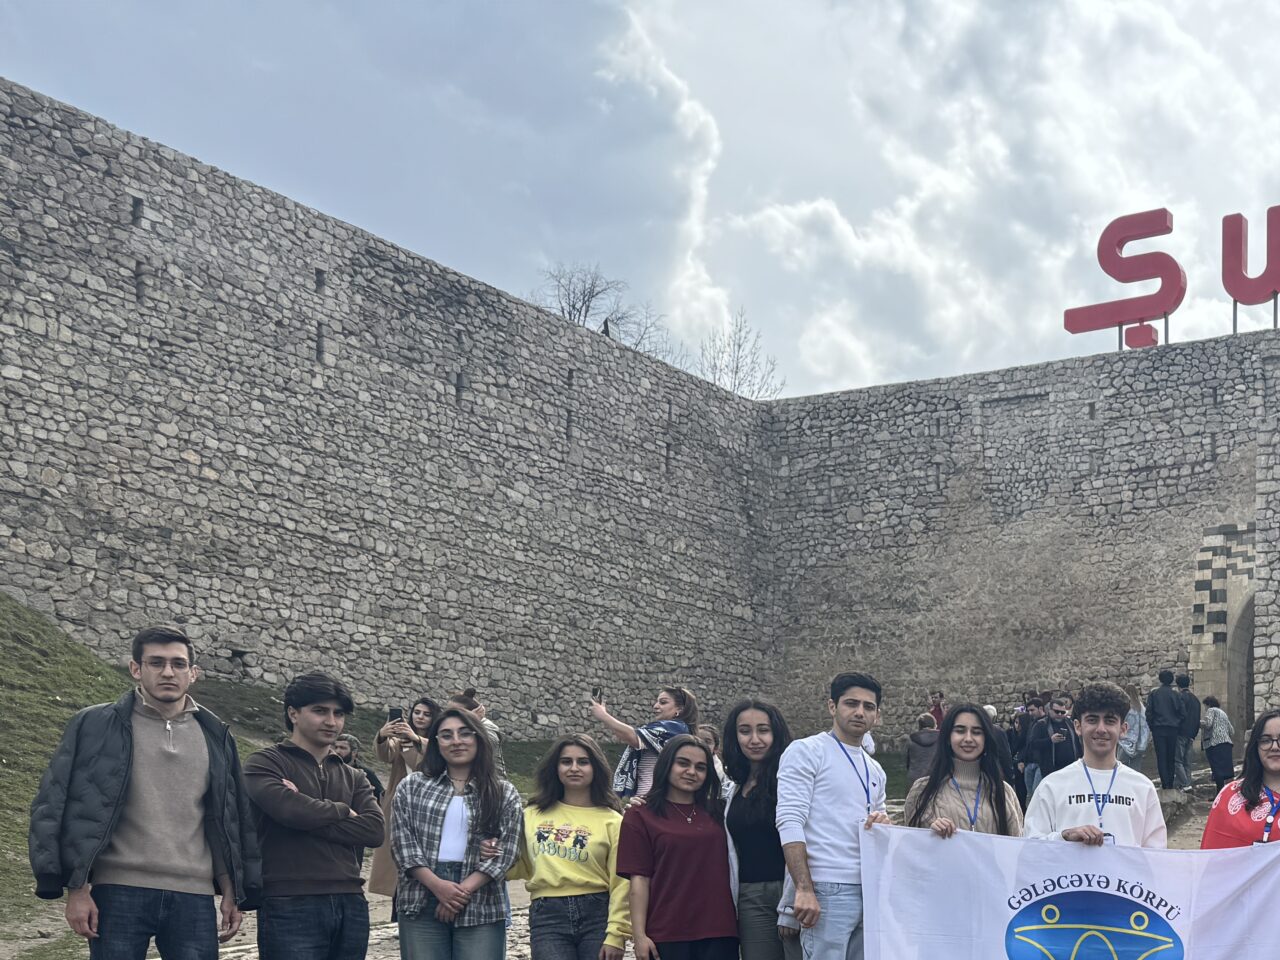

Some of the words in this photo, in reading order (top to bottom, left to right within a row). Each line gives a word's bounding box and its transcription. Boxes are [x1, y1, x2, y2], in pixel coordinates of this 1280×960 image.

[1068, 793, 1086, 805] I'M
[1007, 873, 1111, 911] GƏLƏCƏYƏ
[1115, 878, 1181, 921] KÖRPÜ
